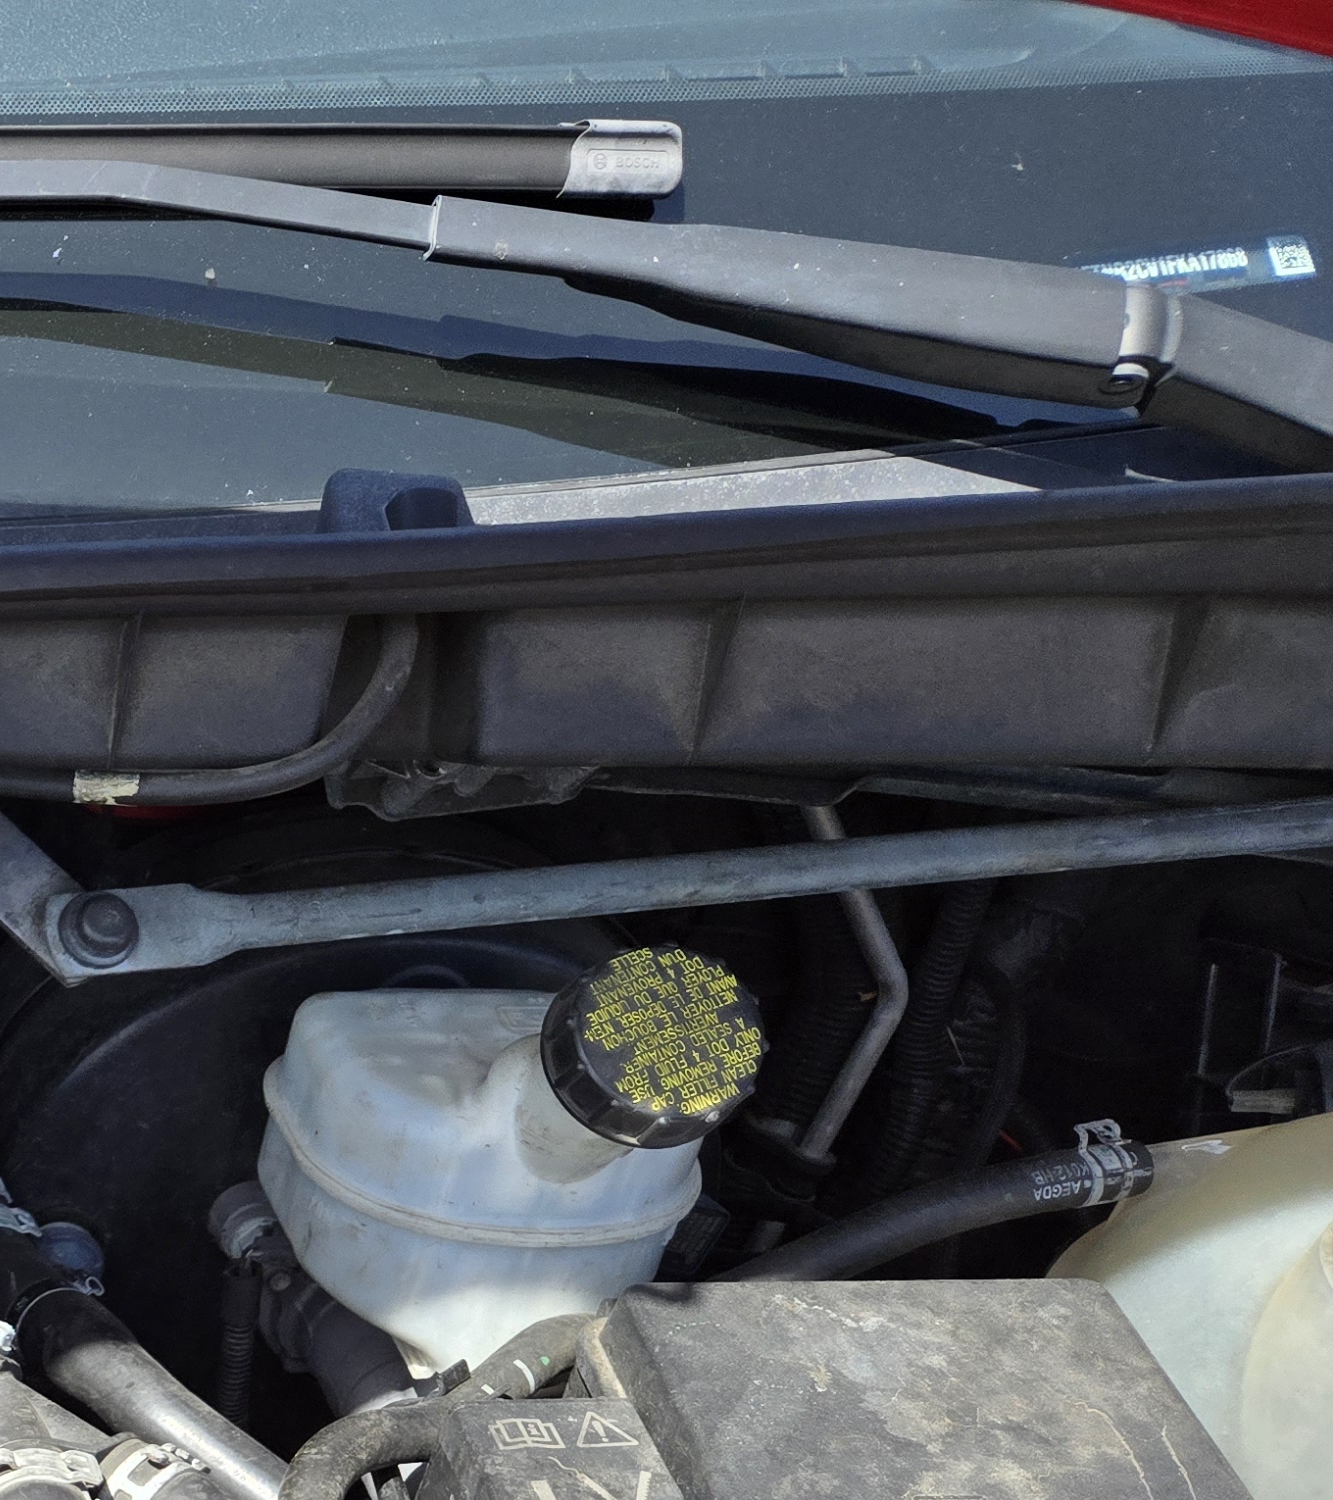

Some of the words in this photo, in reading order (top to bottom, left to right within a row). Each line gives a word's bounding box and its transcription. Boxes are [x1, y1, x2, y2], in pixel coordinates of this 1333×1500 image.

[615, 157, 660, 169] BOSCH
[680, 957, 704, 974] DOT
[590, 960, 656, 995] CONTENANT
[681, 965, 724, 988] PLOYER
[706, 975, 737, 995] AVANT
[597, 973, 663, 1007] PROVENANT
[653, 981, 678, 998] QUE
[587, 1000, 626, 1026] LIQUIDE
[681, 989, 738, 1019] NETTOYER
[602, 1020, 657, 1050] BOUCHON
[690, 1023, 732, 1046] SEALED
[734, 1027, 760, 1047] ONLY
[706, 1038, 729, 1057] DOT
[720, 1042, 760, 1068] BEFORE
[655, 1055, 687, 1076] FLUID
[721, 1060, 756, 1083] CLEAN
[616, 1070, 649, 1092] FROM
[679, 1078, 718, 1099] FILLER
[650, 1092, 674, 1111] CAP
[1033, 1180, 1081, 1201] AEGDA
